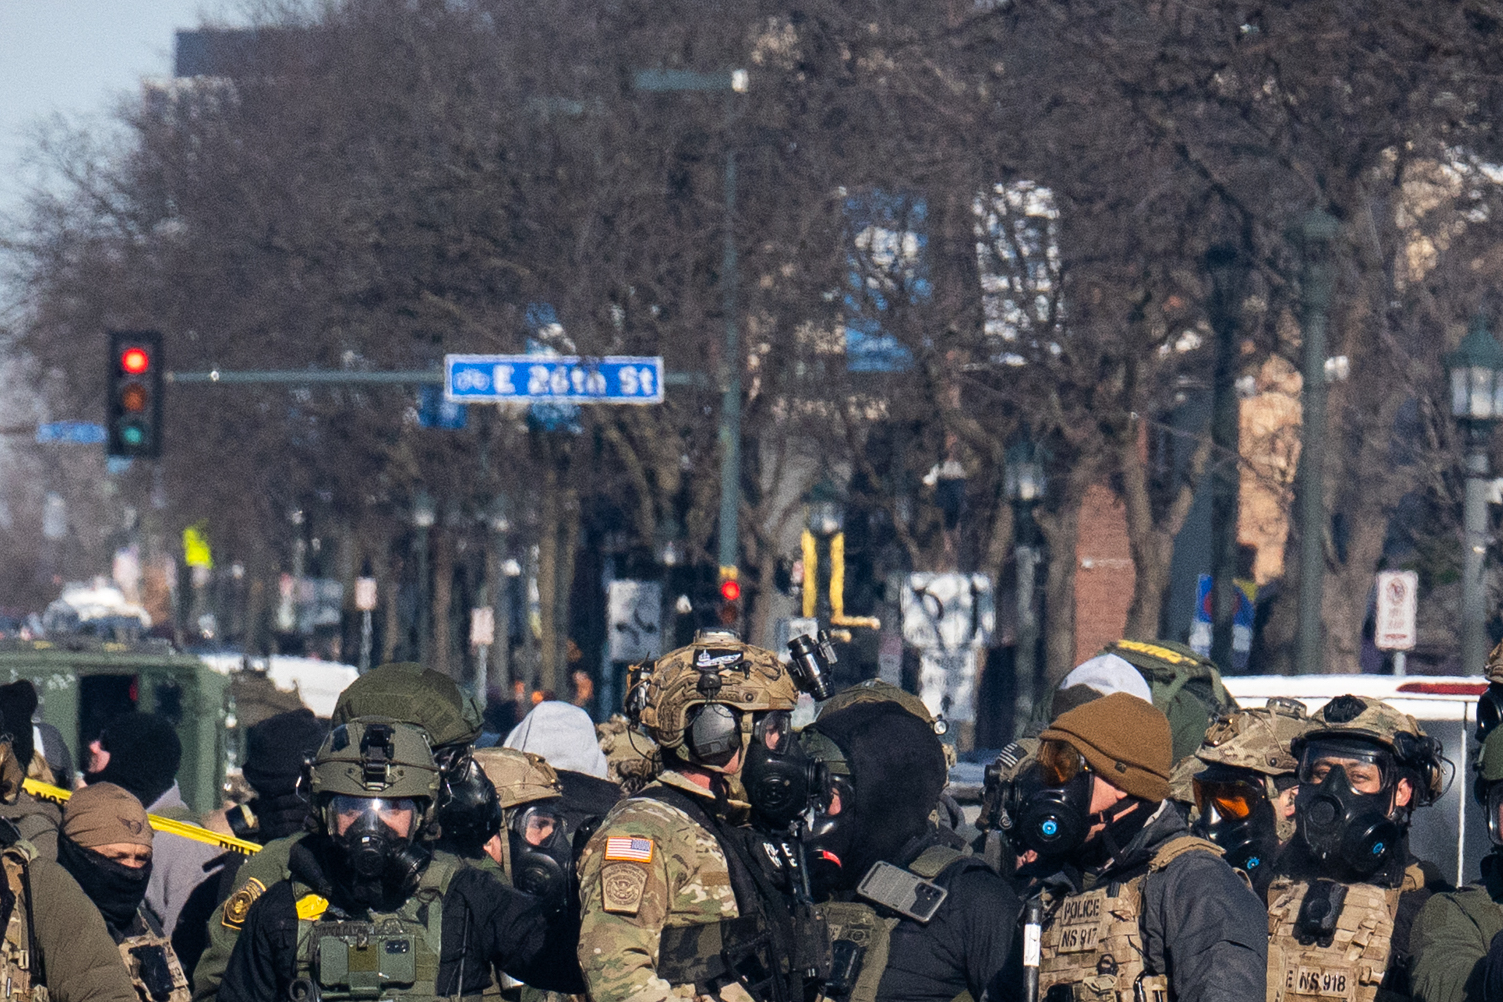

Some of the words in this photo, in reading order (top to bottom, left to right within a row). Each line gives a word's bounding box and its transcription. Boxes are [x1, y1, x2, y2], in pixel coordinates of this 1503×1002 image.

[493, 364, 515, 394] E
[618, 365, 654, 395] St
[1063, 899, 1100, 920] POLICE
[1061, 929, 1078, 947] NS
[1299, 971, 1320, 990] NS
[1323, 974, 1346, 992] 918
